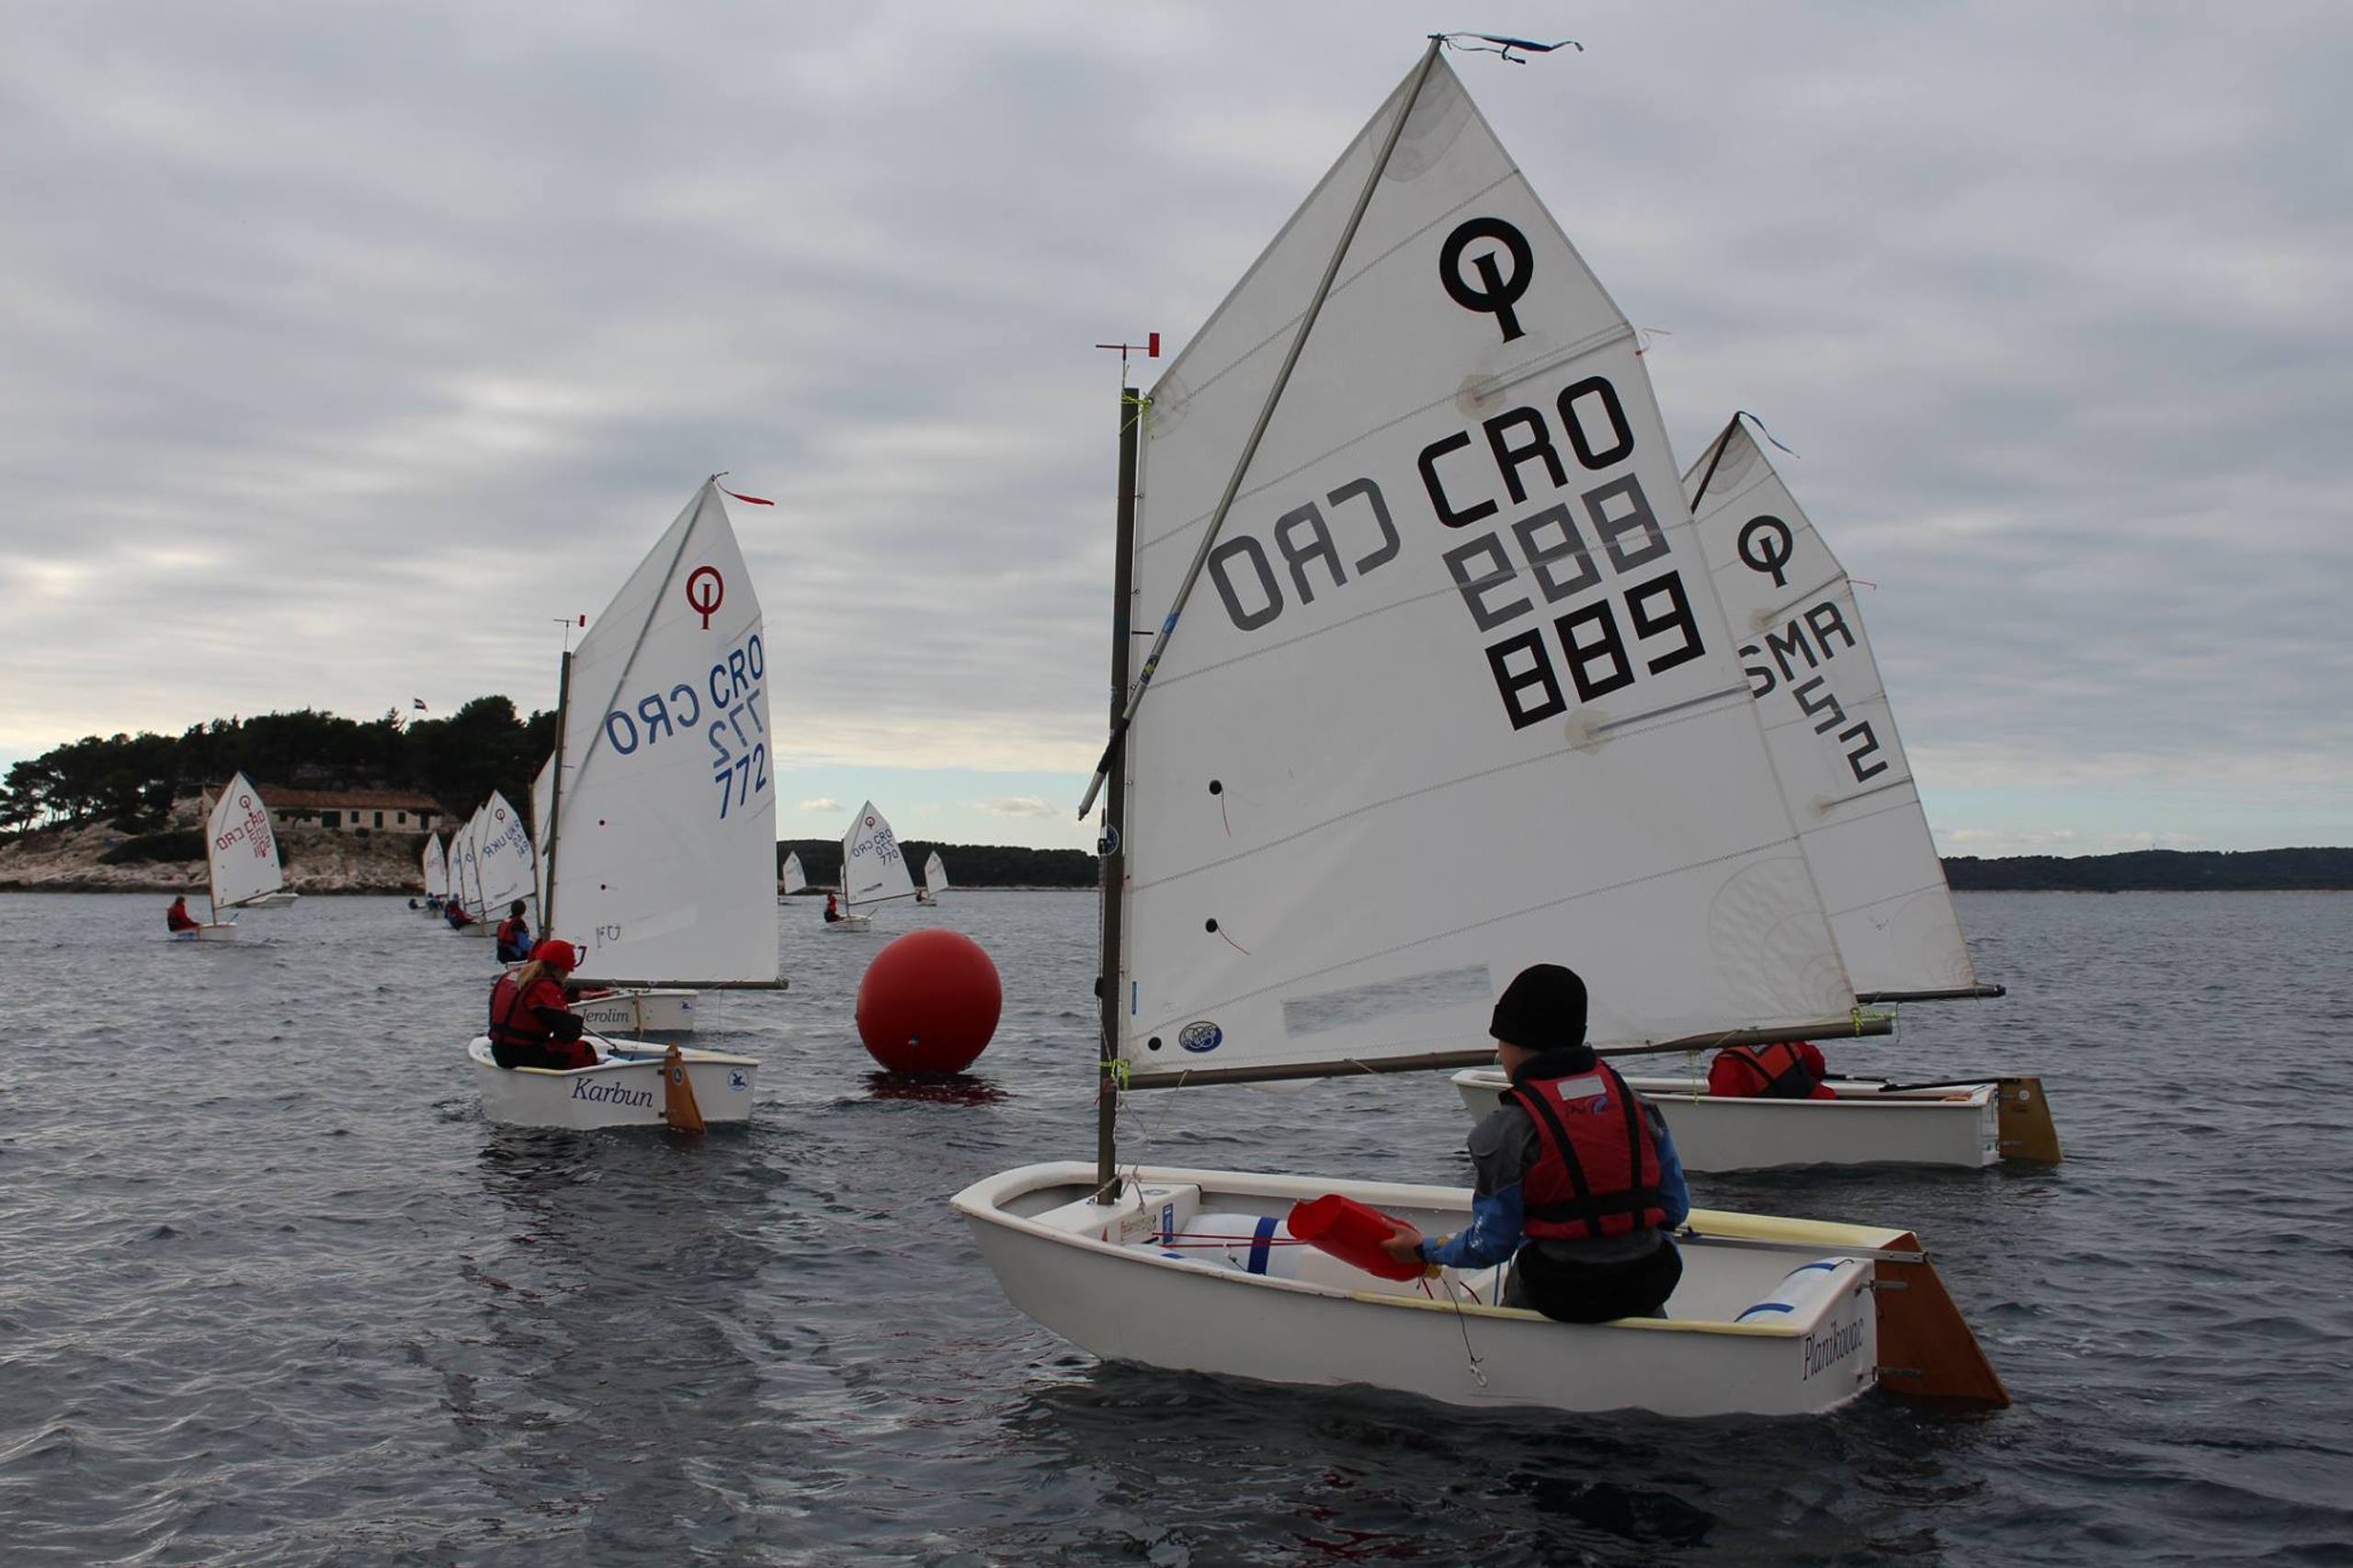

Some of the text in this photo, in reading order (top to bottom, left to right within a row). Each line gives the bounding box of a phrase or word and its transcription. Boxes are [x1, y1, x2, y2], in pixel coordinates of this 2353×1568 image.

[1418, 376, 1634, 528] CRO
[709, 634, 764, 710] CRO
[1485, 570, 1706, 732] 889
[1739, 602, 1857, 699] SMR
[715, 743, 767, 820] 772
[873, 828, 892, 845] CRO
[880, 848, 899, 865] 770
[571, 1077, 654, 1108] Karbun
